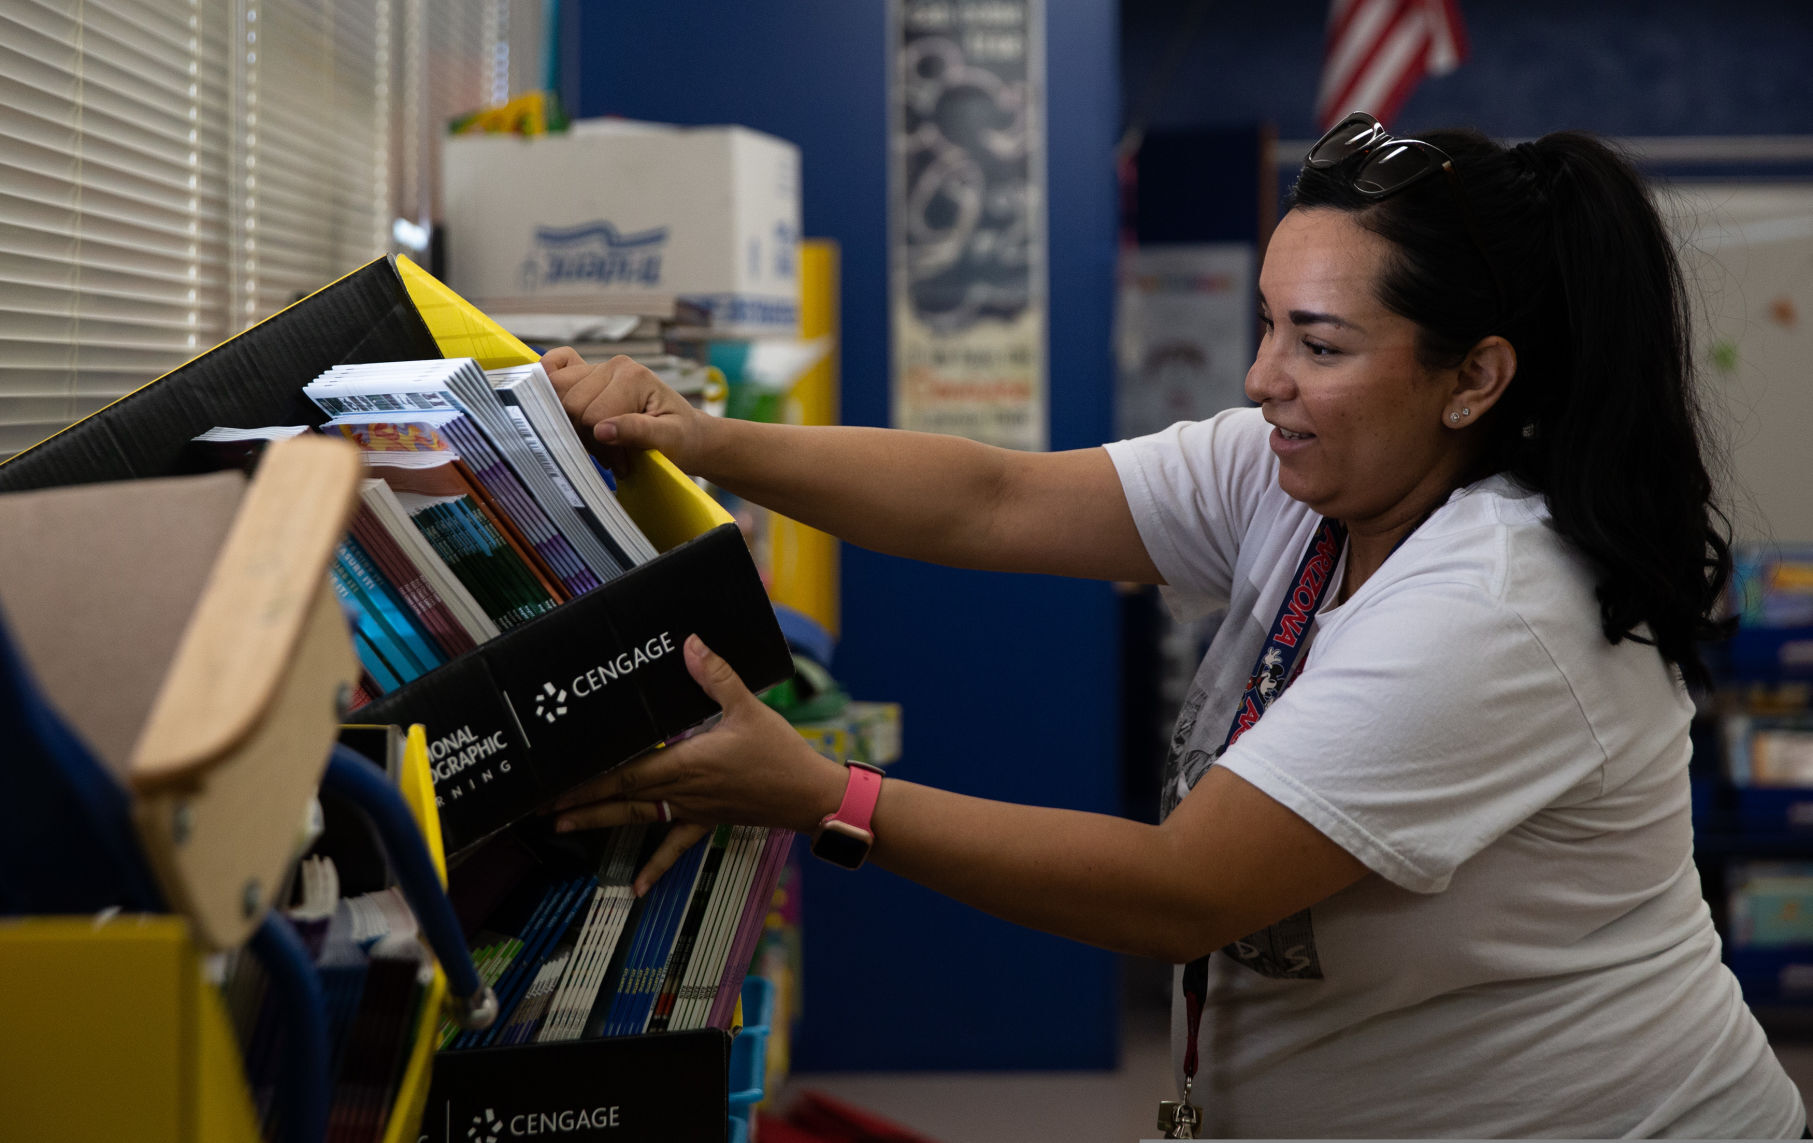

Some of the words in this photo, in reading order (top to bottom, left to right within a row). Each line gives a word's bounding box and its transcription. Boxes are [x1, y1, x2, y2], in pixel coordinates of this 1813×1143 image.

[1274, 527, 1338, 648] ARIZONA
[572, 631, 675, 697] CENGAGE
[510, 1105, 621, 1136] CENGAGE
